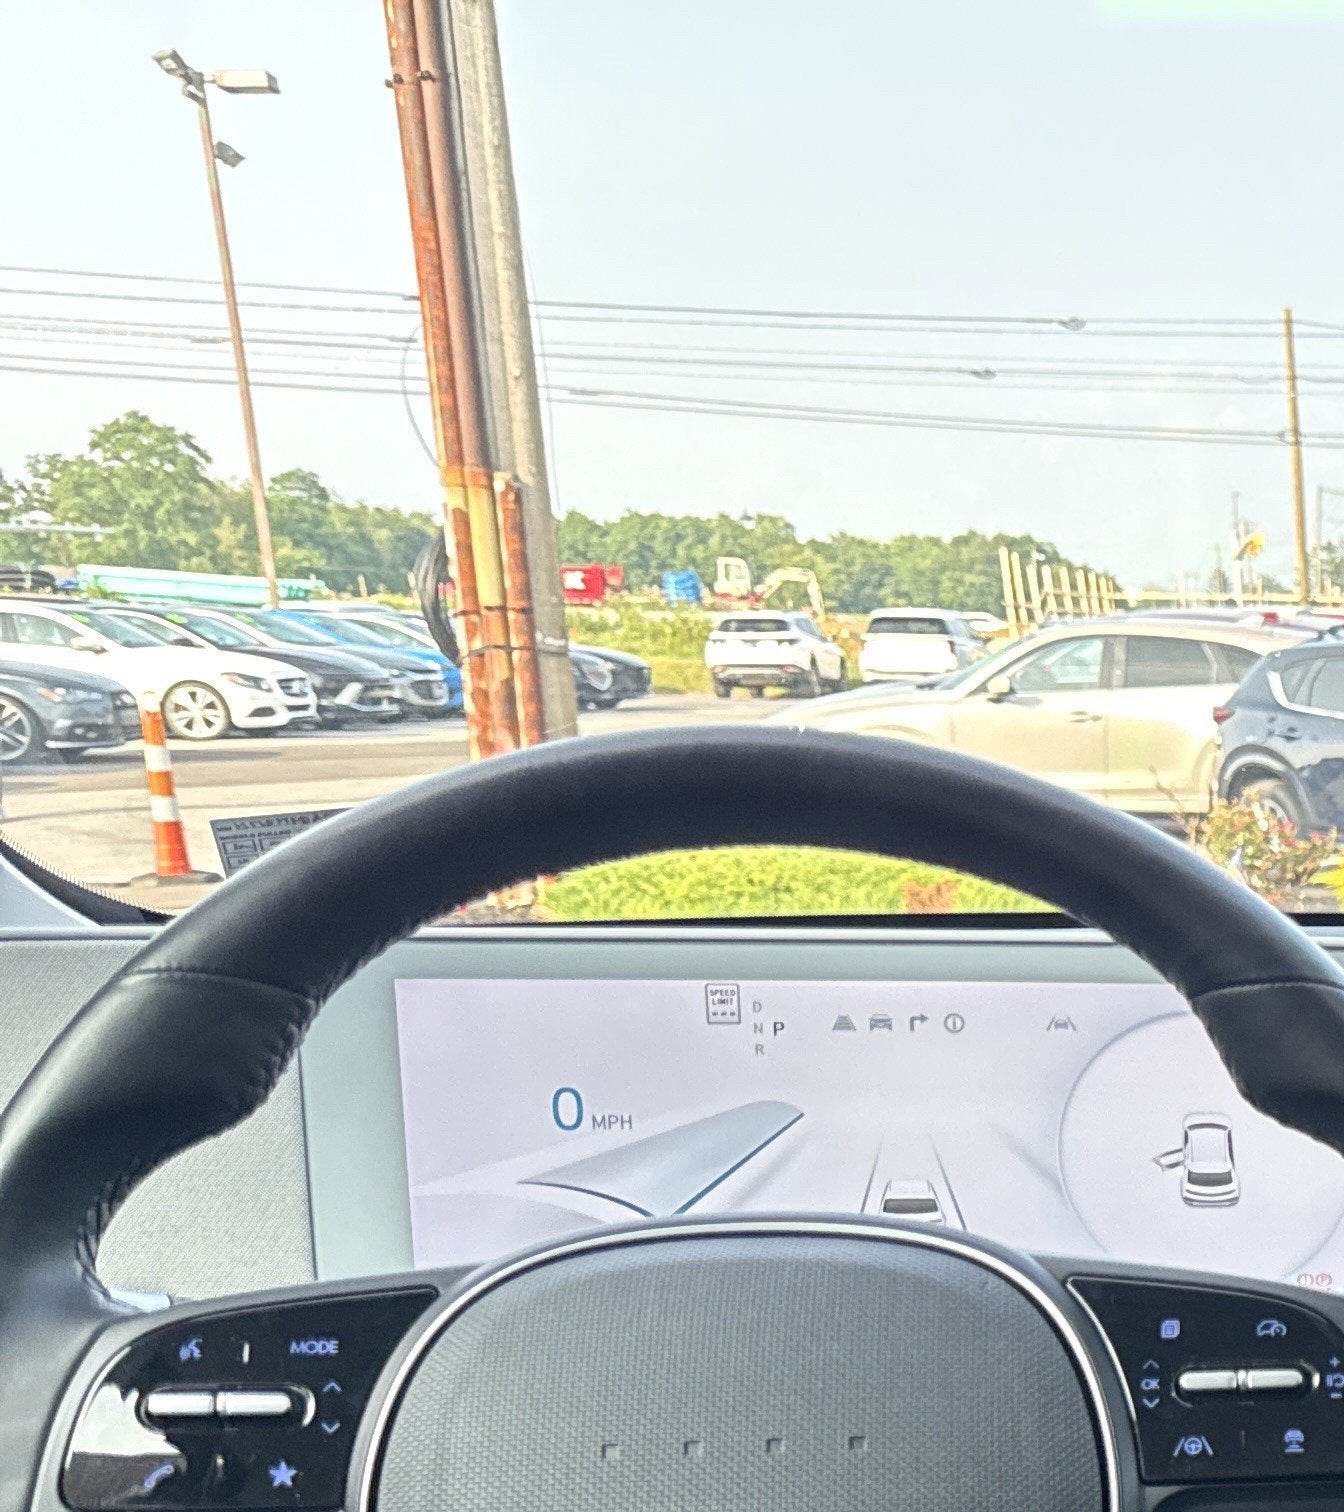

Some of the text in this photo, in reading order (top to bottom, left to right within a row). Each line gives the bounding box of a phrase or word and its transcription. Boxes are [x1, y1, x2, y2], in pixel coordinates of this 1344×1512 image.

[710, 989, 736, 997] SPEED
[712, 998, 734, 1006] LIMIT
[753, 1001, 762, 1013] D
[754, 1021, 785, 1036] N P
[755, 1044, 764, 1056] R
[552, 1087, 633, 1131] 0 MPH
[289, 1340, 339, 1355] MODE
[1140, 1378, 1160, 1390] OK
